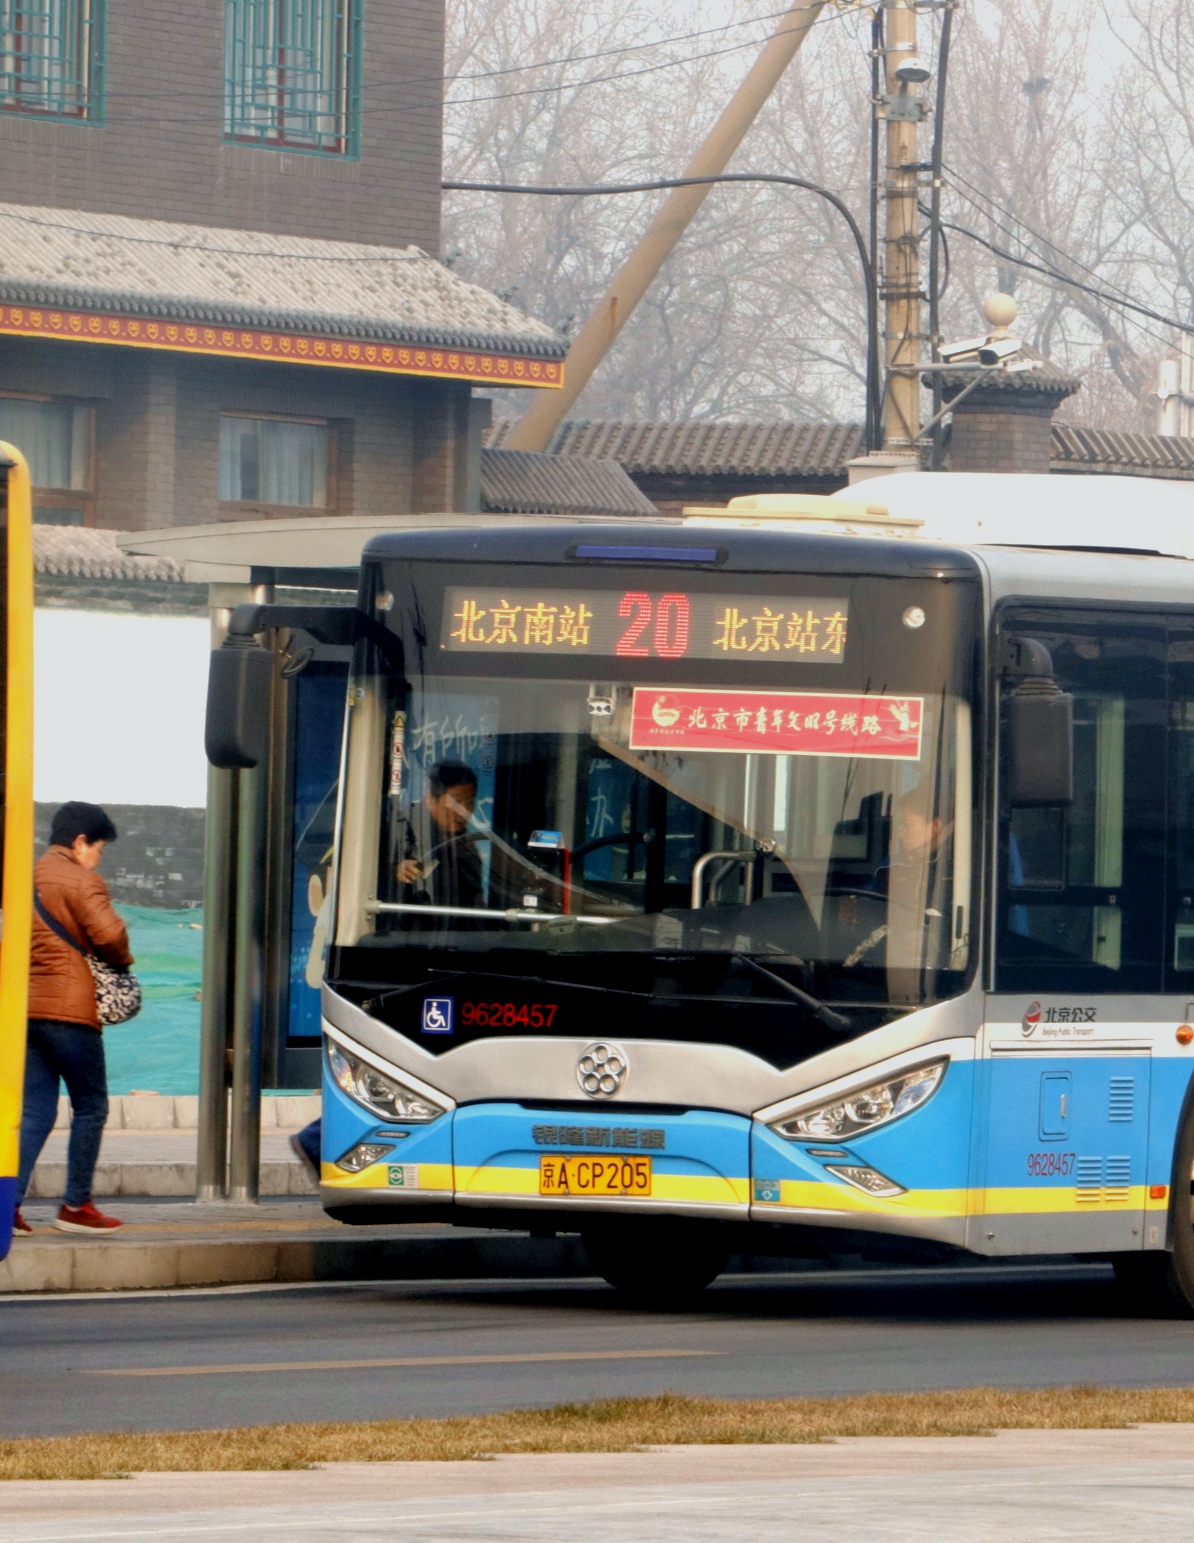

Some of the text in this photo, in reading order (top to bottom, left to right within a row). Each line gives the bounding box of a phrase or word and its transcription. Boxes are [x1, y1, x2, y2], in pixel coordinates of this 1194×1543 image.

[451, 591, 848, 657] 北京南站 20 北京站东
[461, 1002, 558, 1028] 9628457
[1044, 1007, 1097, 1022] 北京公交
[1042, 1027, 1094, 1037] Beijing Public Transport
[532, 1124, 665, 1149] 银隆新能源
[1027, 1153, 1076, 1176] 9628457
